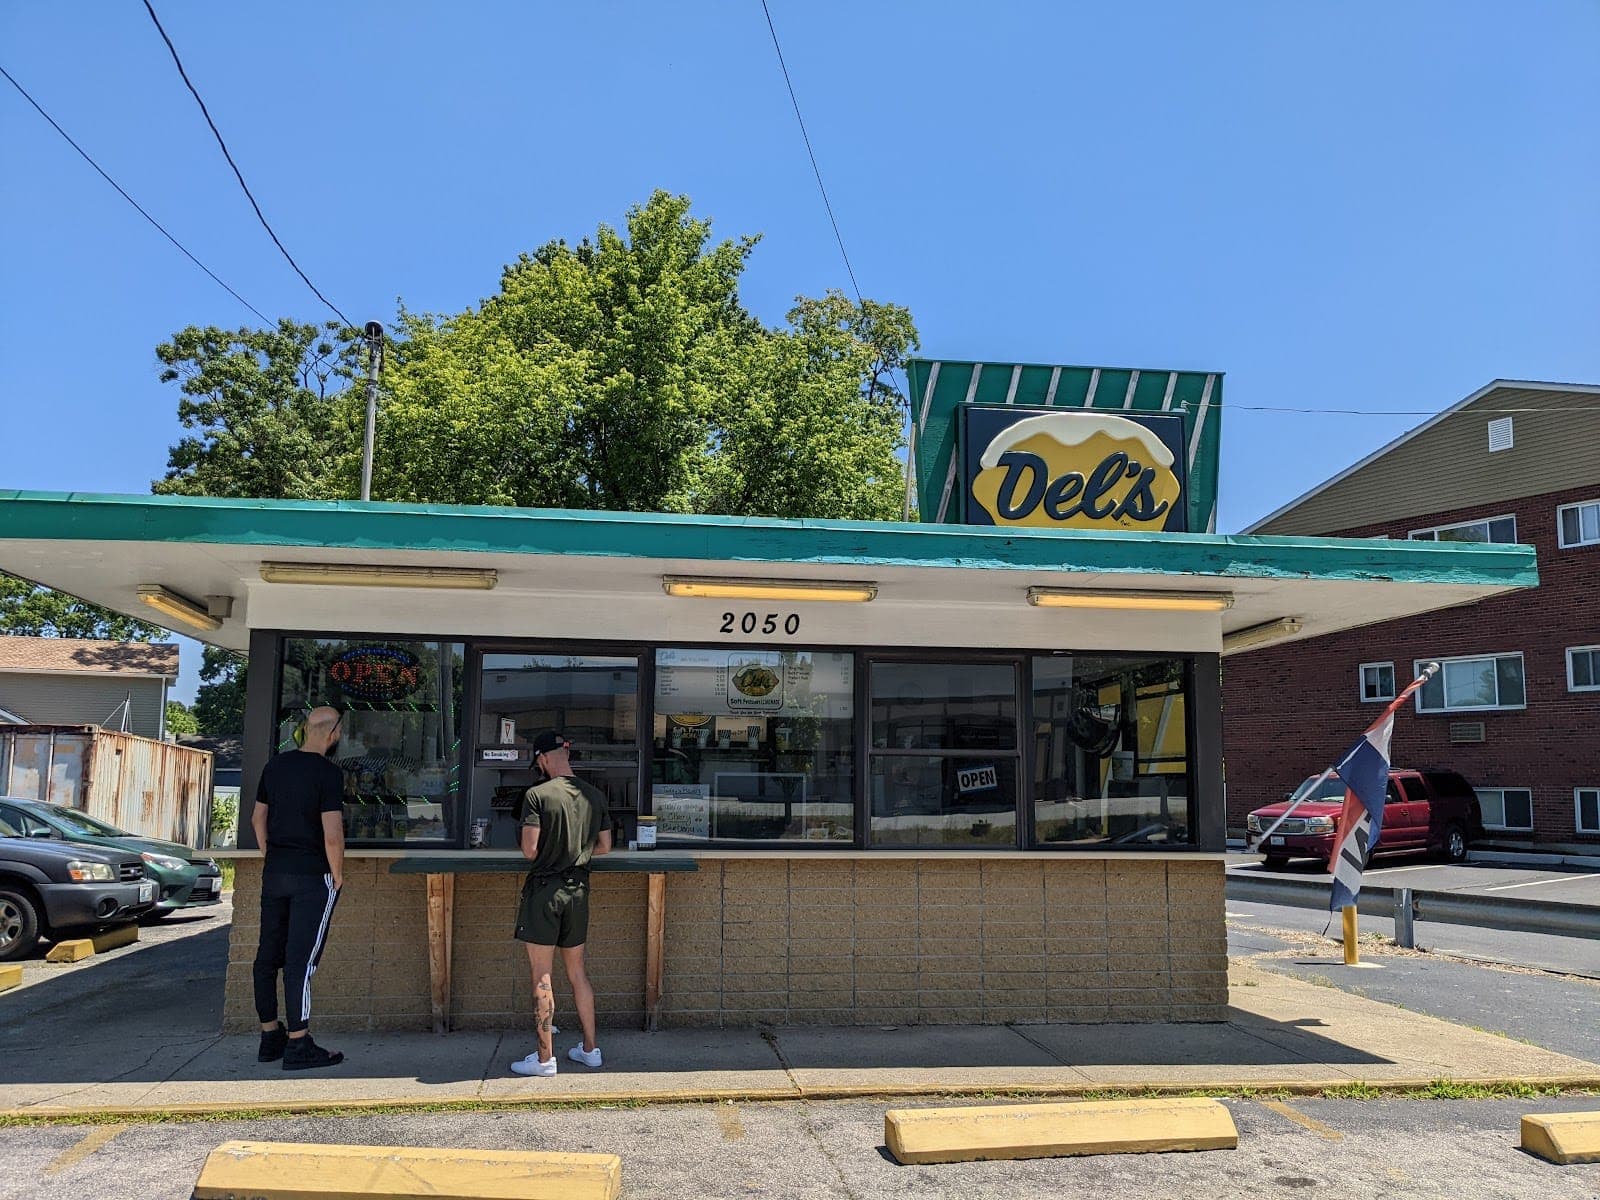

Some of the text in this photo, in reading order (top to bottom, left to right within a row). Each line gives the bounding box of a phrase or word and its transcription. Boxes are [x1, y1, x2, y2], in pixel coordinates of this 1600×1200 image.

[996, 450, 1169, 522] Del's
[719, 611, 800, 635] 2050
[329, 660, 419, 686] OPEN
[960, 769, 995, 788] OPEN
